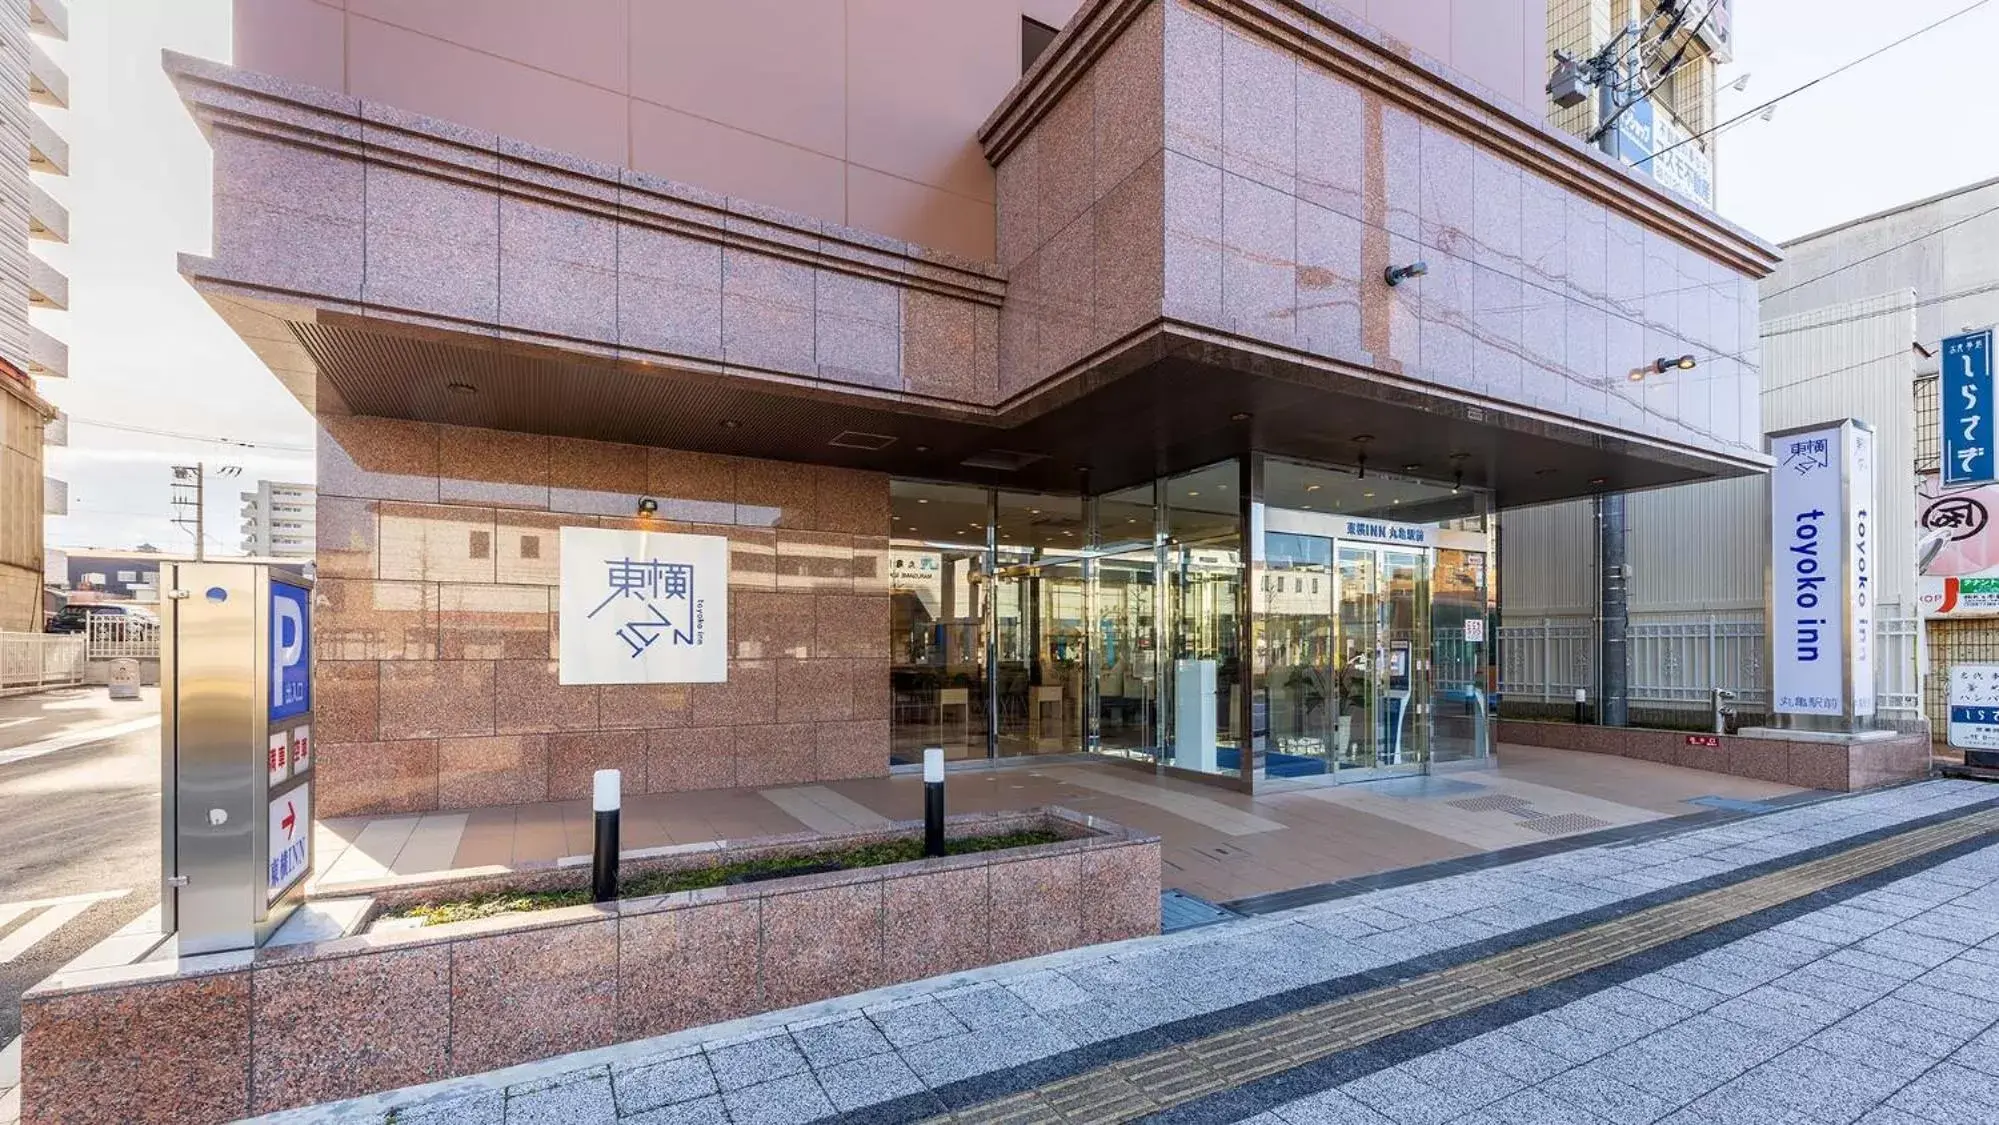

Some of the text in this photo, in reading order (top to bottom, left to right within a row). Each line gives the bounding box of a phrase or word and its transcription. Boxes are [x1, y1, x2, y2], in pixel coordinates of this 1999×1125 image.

[1346, 522, 1386, 538] 東横INN
[1789, 509, 1826, 662] toyoko inn
[1856, 509, 1868, 662] toyoko inn
[696, 599, 704, 645] toyoko inn
[273, 595, 303, 707] P
[285, 682, 303, 704] 出入口
[1779, 695, 1838, 710] 丸亀駅前
[271, 837, 305, 888] 東横INN
